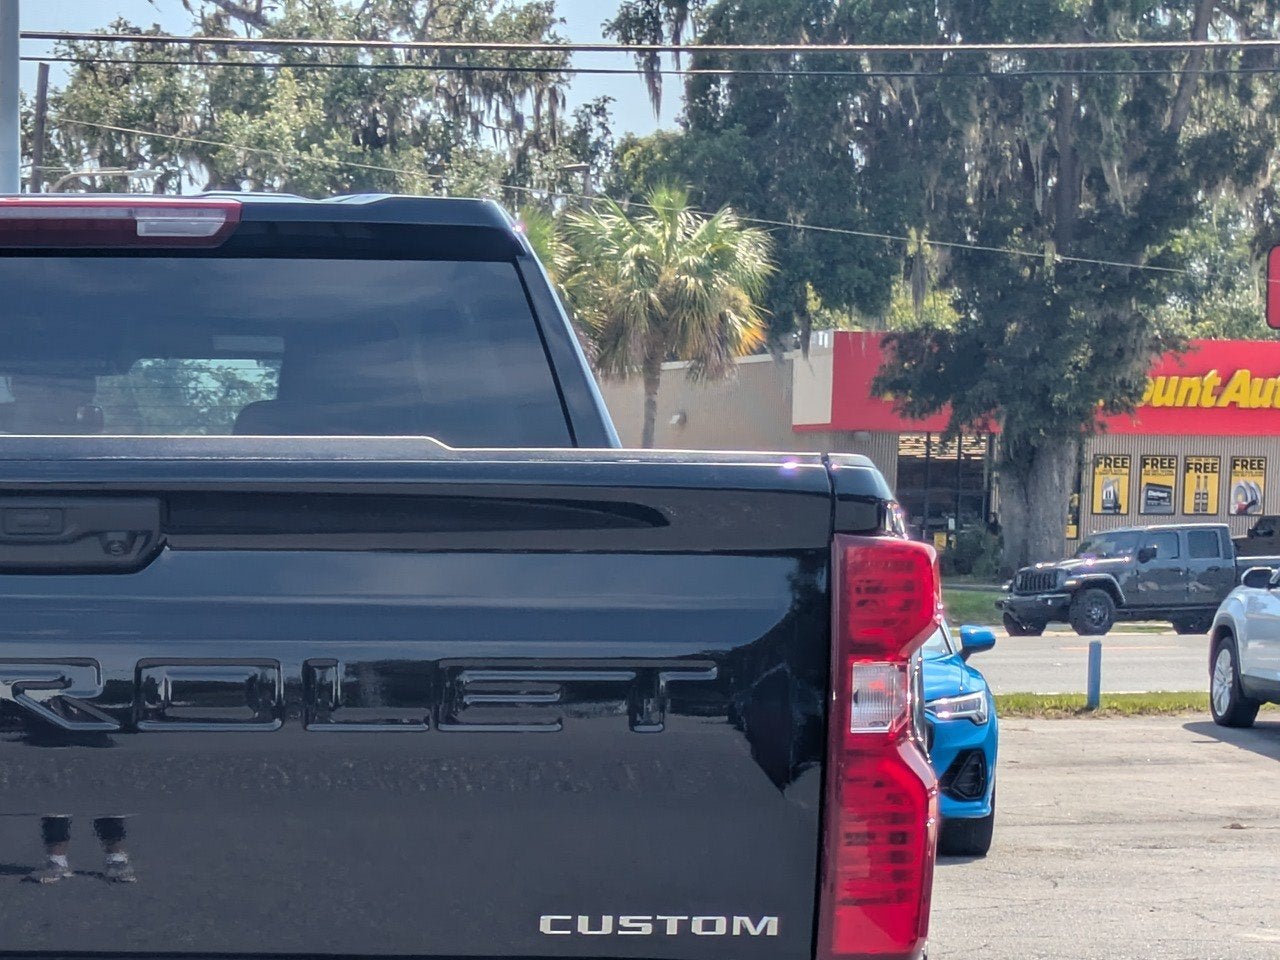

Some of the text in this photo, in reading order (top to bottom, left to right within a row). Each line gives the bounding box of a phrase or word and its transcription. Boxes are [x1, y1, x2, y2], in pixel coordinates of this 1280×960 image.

[1096, 457, 1129, 468] FREE
[1143, 457, 1175, 469] FREE
[1186, 462, 1218, 473] FREE
[1233, 459, 1264, 470] FREE
[540, 915, 778, 936] CUSTOM
